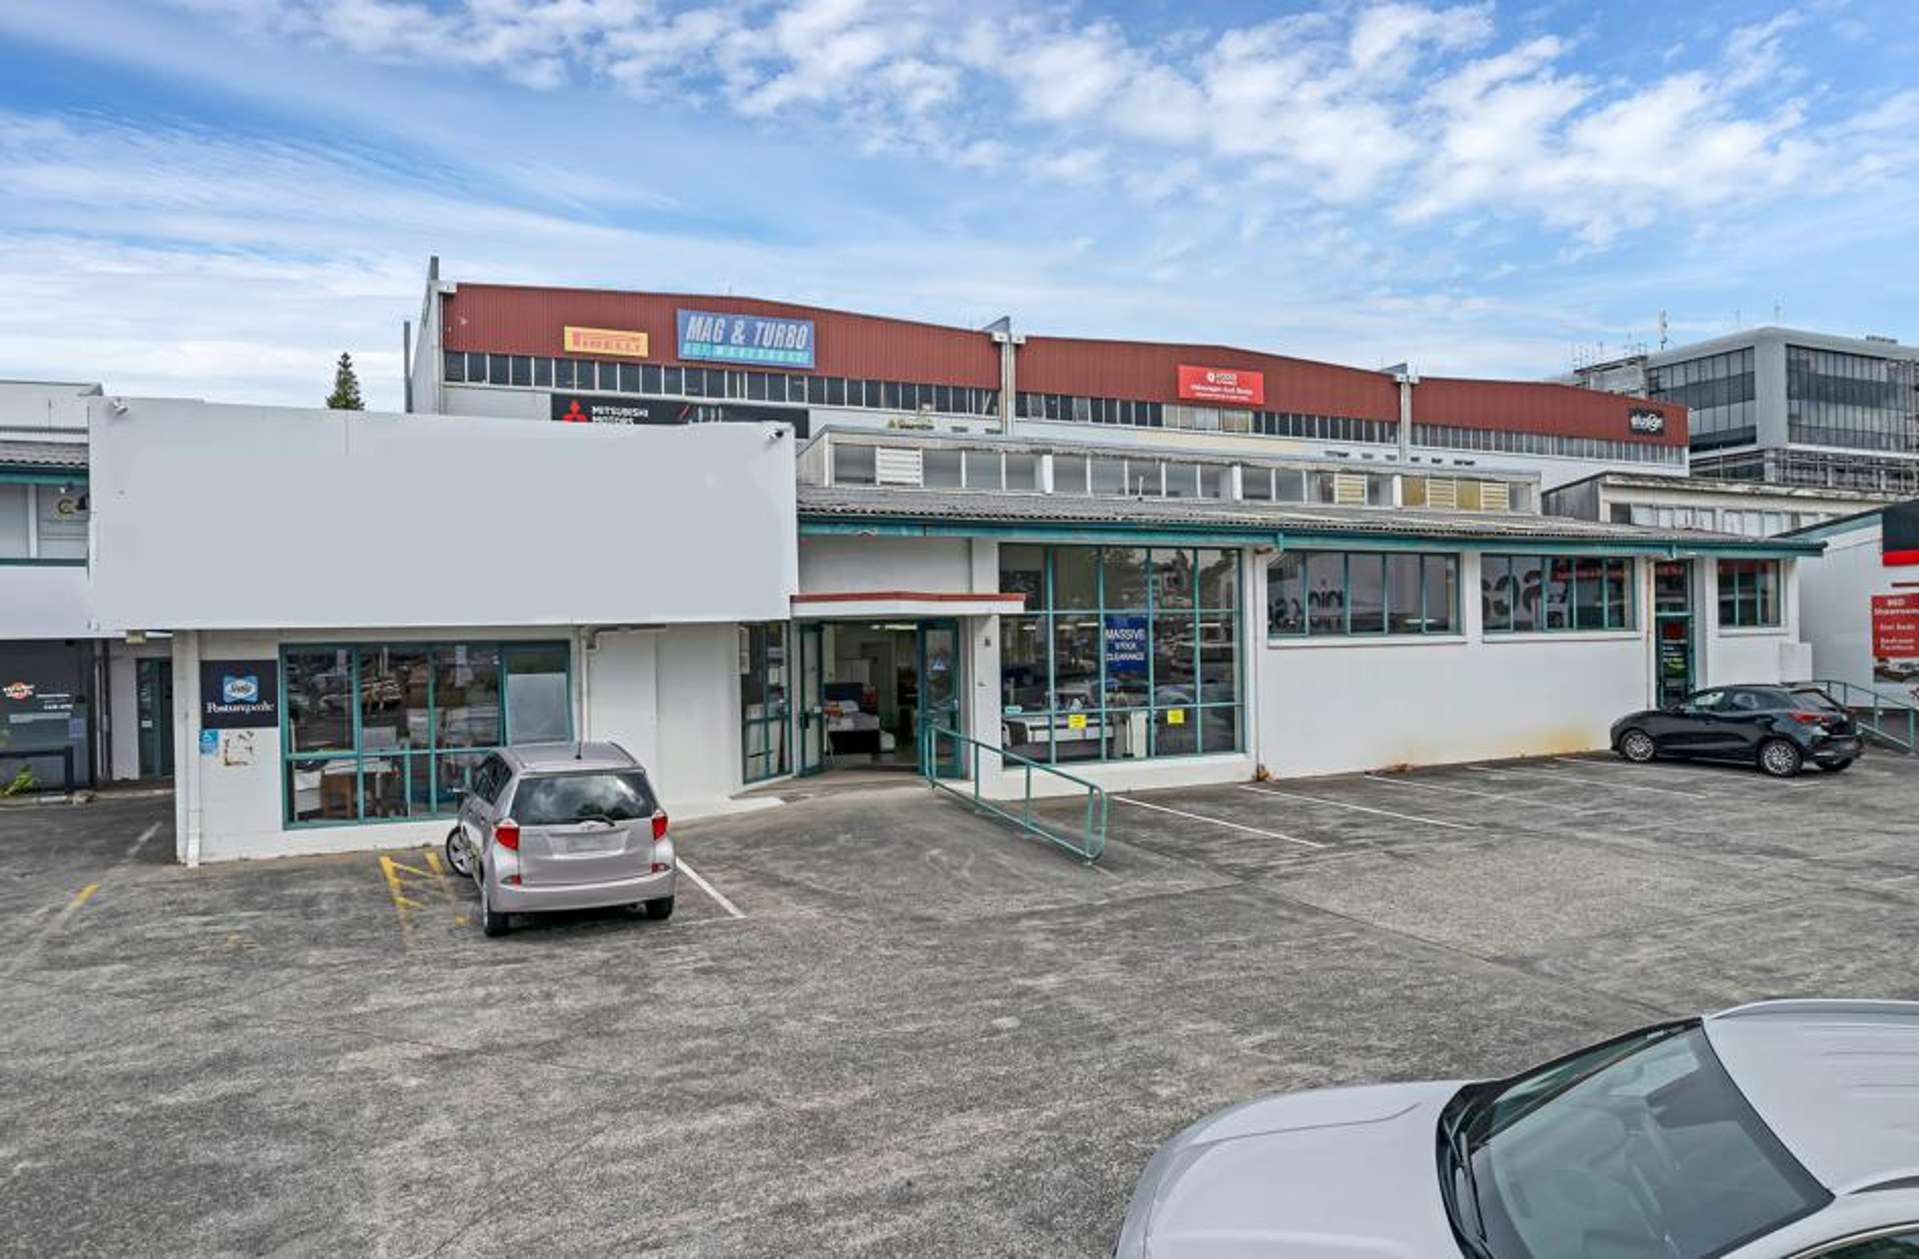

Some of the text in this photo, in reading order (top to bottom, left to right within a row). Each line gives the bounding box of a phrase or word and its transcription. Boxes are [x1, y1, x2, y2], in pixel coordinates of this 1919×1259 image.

[686, 315, 809, 350] MAG & TURBO
[591, 405, 649, 418] MITSUBISHI
[1105, 628, 1145, 640] MASSIVE
